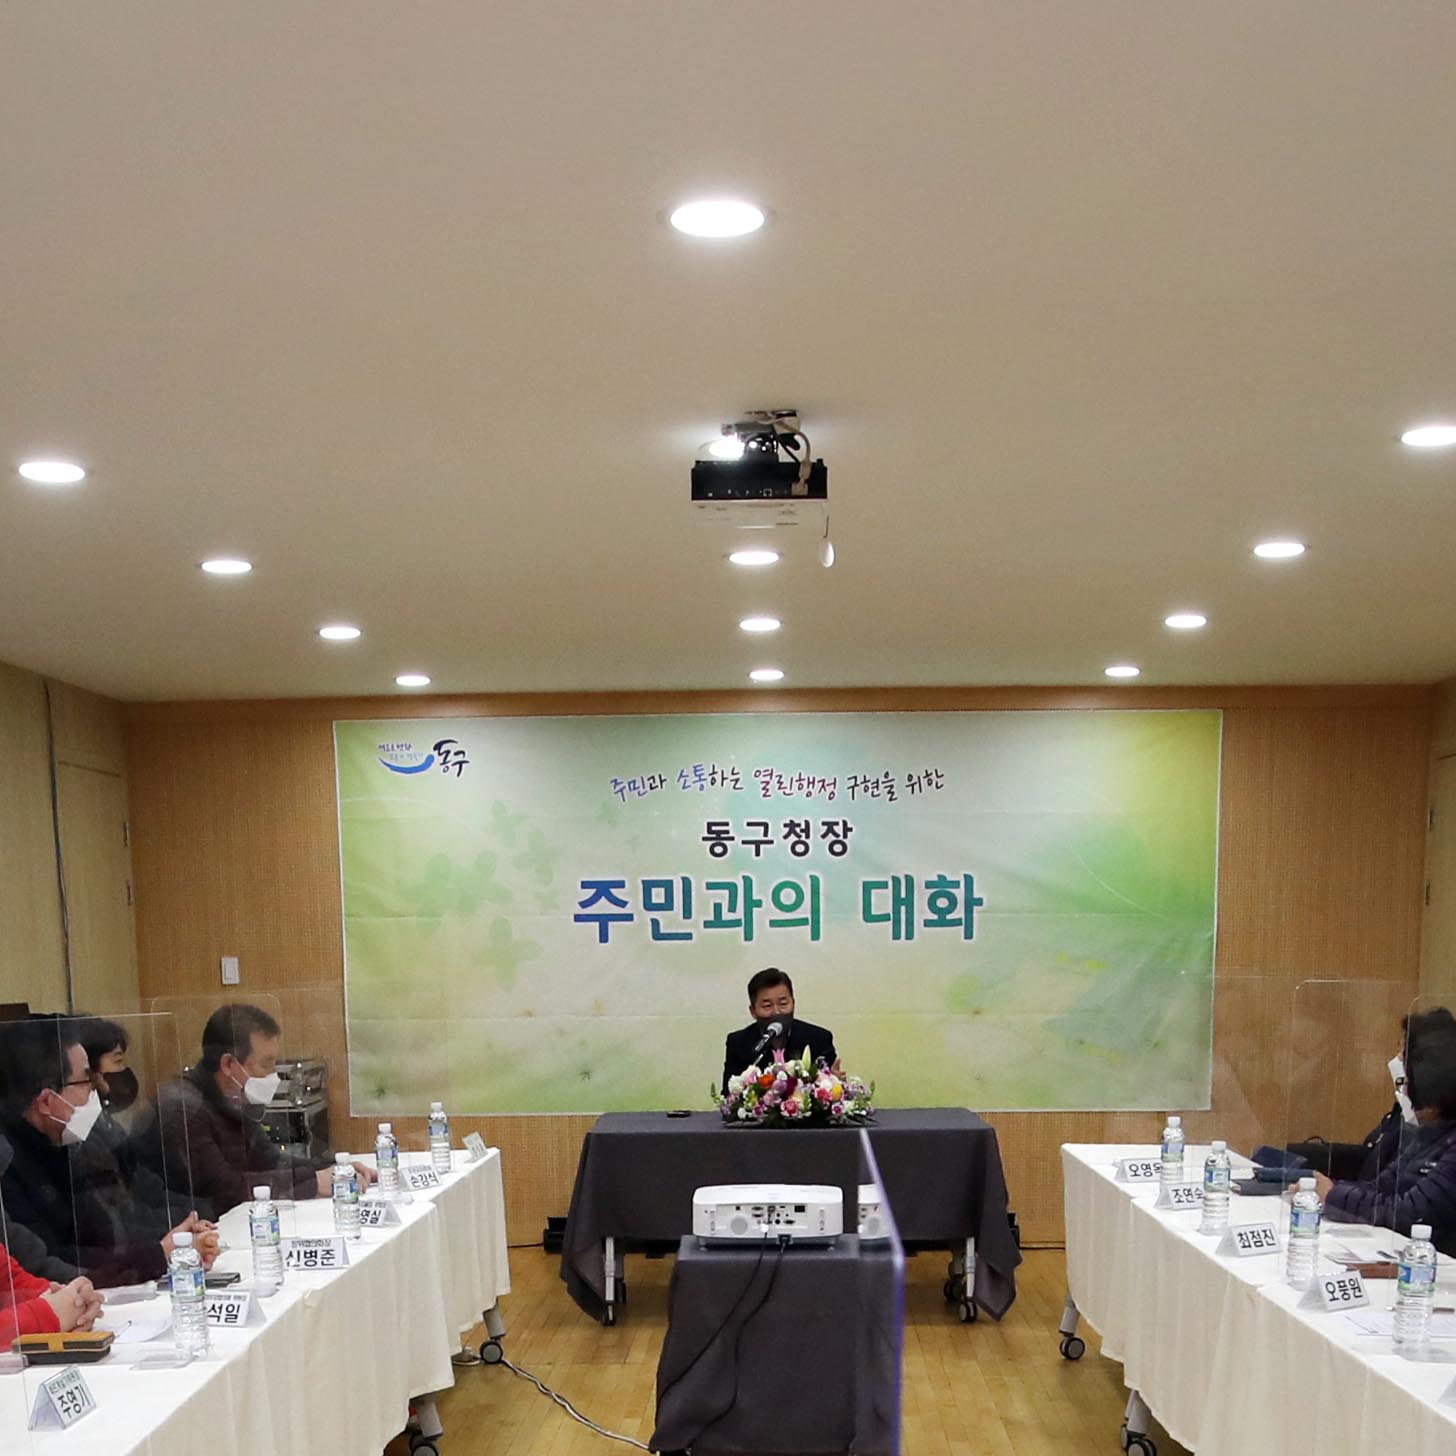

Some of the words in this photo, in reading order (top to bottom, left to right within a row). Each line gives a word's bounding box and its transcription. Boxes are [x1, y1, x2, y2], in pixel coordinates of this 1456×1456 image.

[433, 739, 470, 778] 동구
[610, 773, 667, 802] 주민과
[676, 764, 744, 791] 소통하는
[753, 768, 838, 801] 열린행정
[846, 770, 898, 802] 구현을
[905, 768, 945, 795] 위한
[701, 819, 853, 858] 동구청장
[573, 874, 820, 943] 주민과의
[862, 873, 984, 941] 대화
[1237, 1228, 1277, 1248] 최점진
[285, 1249, 335, 1267] 신병준
[1325, 1277, 1363, 1301] 오풍원
[204, 1303, 241, 1323] 석일
